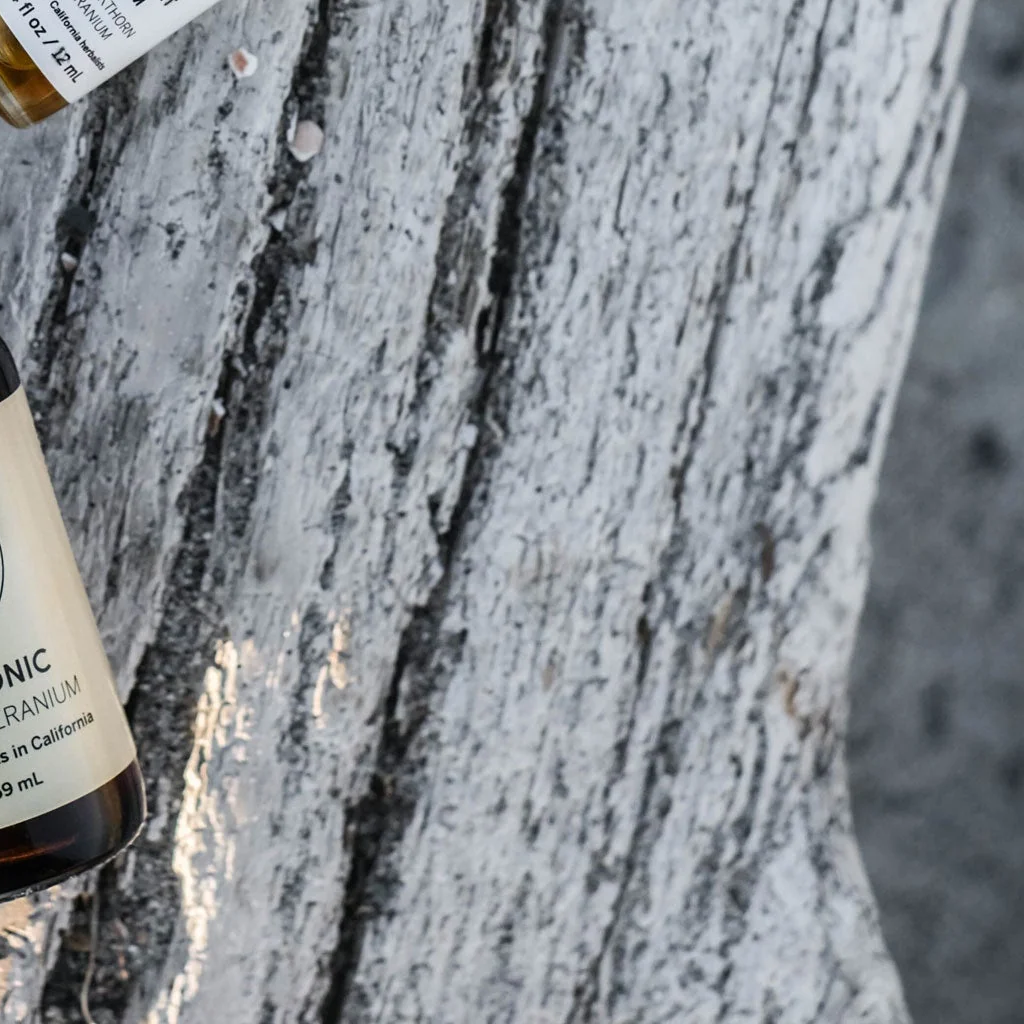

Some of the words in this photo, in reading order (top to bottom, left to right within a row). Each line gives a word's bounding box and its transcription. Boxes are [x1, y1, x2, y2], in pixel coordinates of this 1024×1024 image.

[19, 2, 34, 16] fl
[29, 18, 46, 37] oz
[51, 47, 71, 66] 12
[64, 65, 83, 83] mL
[50, 0, 82, 42] California
[79, 39, 105, 70] herbalists
[12, 745, 28, 758] in
[31, 711, 94, 750] California
[17, 772, 44, 792] mL
